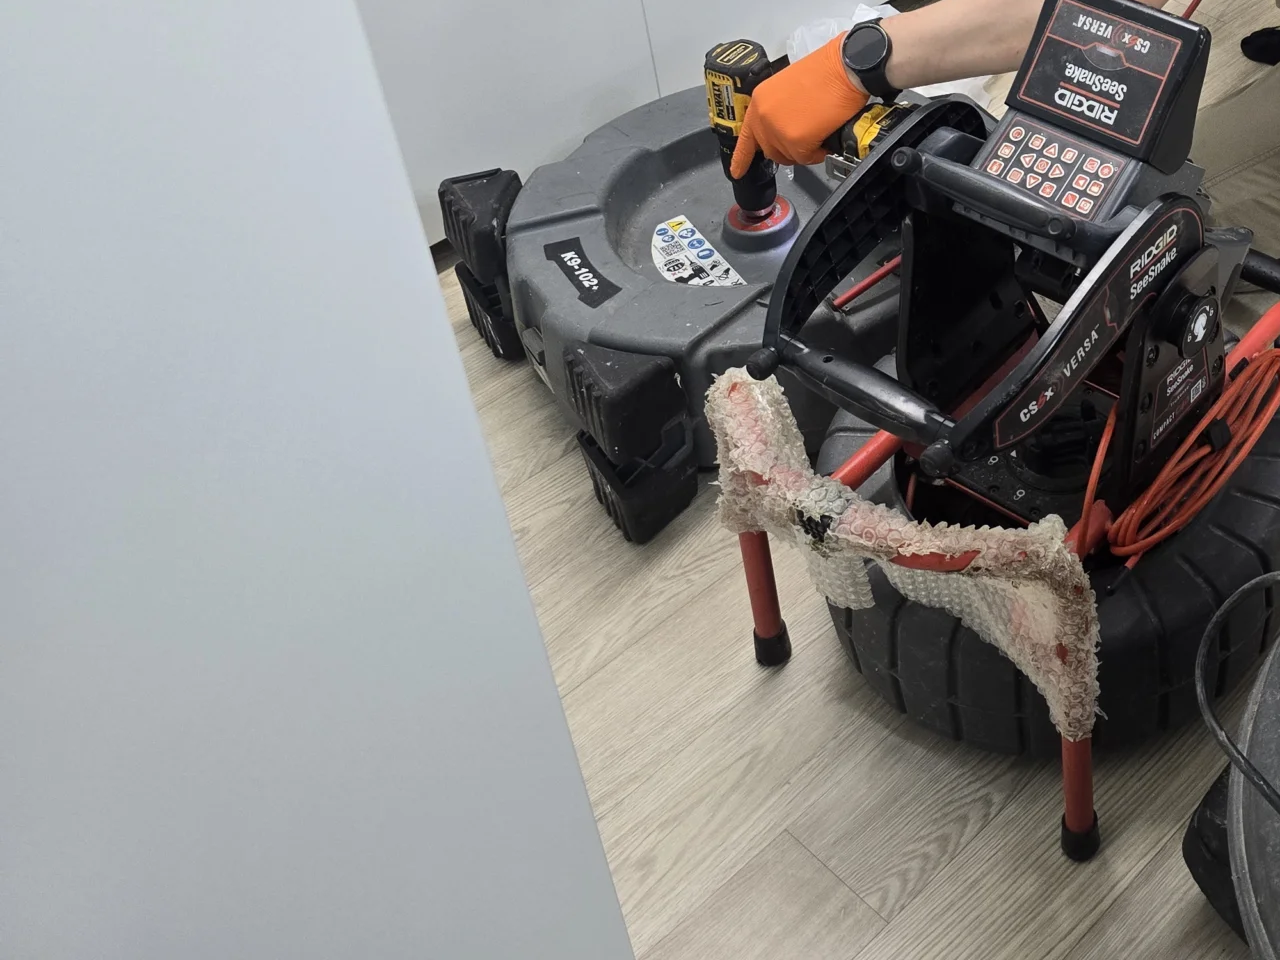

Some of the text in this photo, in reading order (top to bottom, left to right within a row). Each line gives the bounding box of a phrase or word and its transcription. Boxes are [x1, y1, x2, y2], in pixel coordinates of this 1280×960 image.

[1054, 87, 1119, 126] RIDGID
[560, 250, 599, 291] K9-102+
[1130, 224, 1178, 279] RIDGID
[1130, 247, 1178, 300] SeeSnake
[1063, 329, 1099, 378] VERSA
